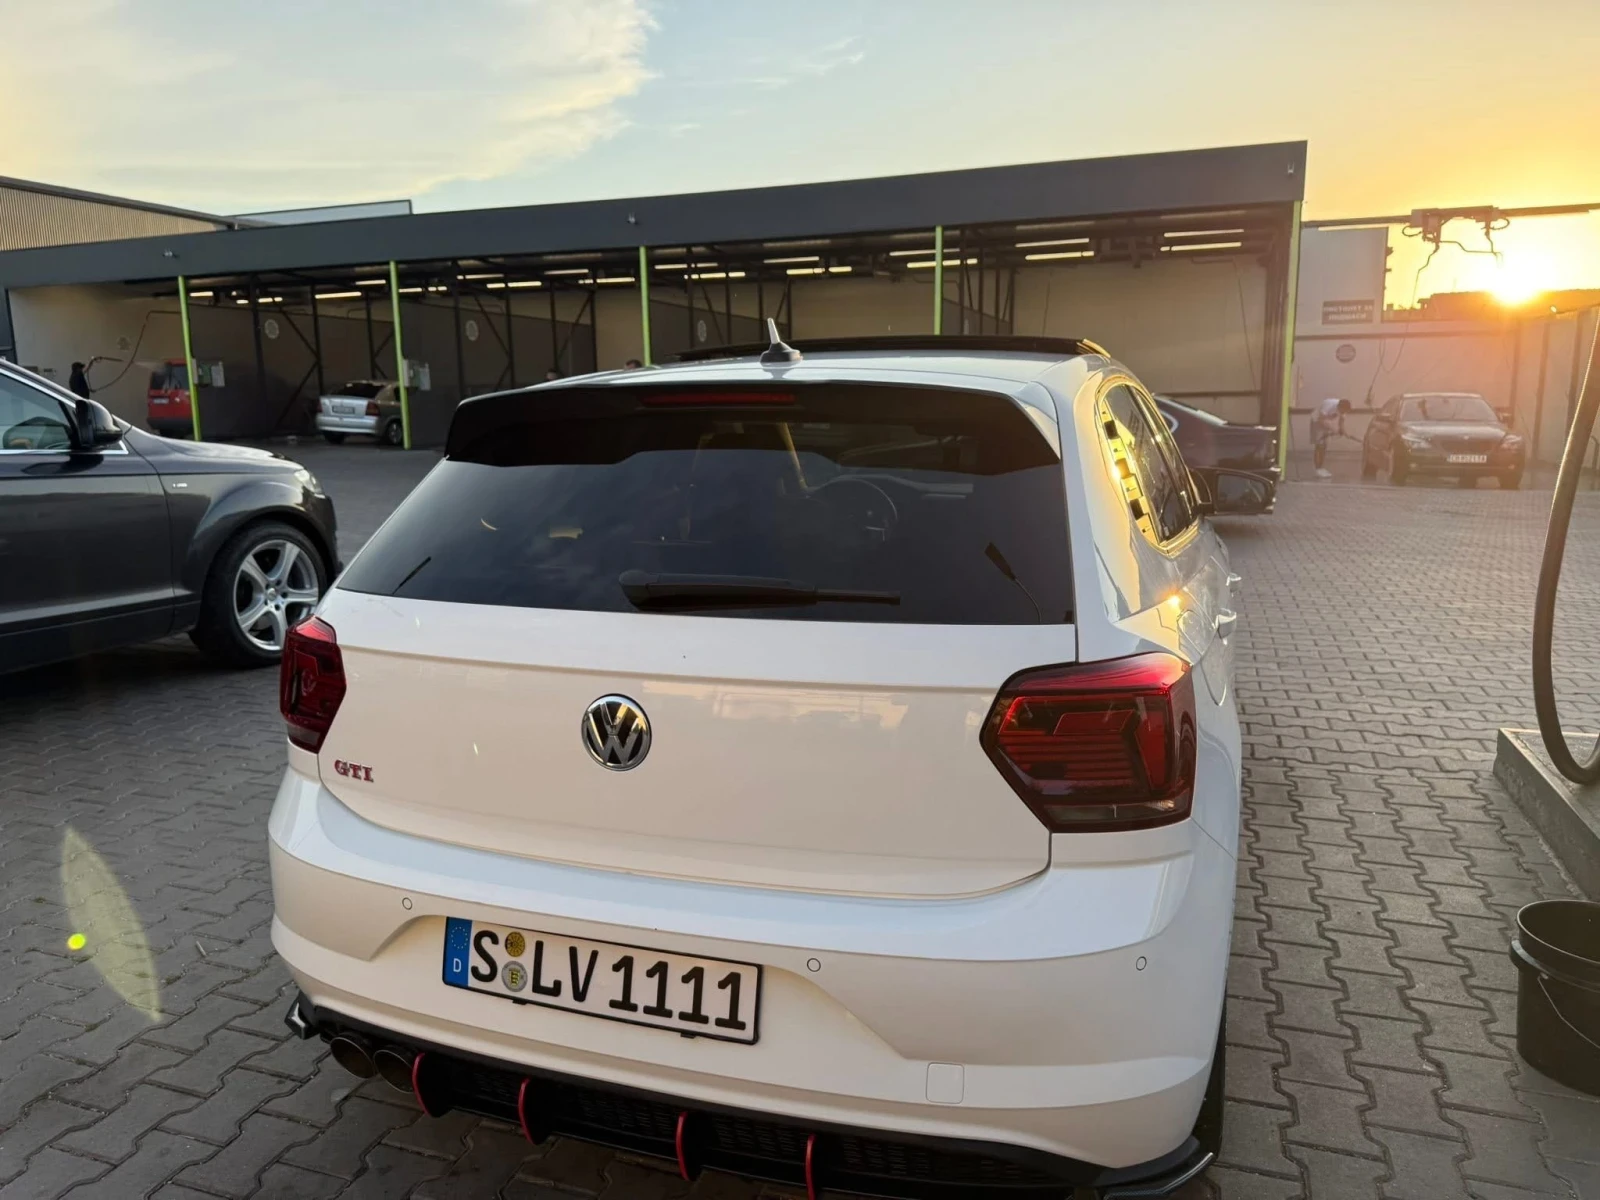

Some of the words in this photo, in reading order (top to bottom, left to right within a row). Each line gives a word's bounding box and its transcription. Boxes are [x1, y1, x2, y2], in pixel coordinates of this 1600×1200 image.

[584, 697, 649, 769] VW
[334, 759, 374, 783] GTI
[453, 957, 462, 973] D
[471, 930, 499, 983] S
[531, 940, 599, 1003] LV
[608, 955, 747, 1031] 1111
